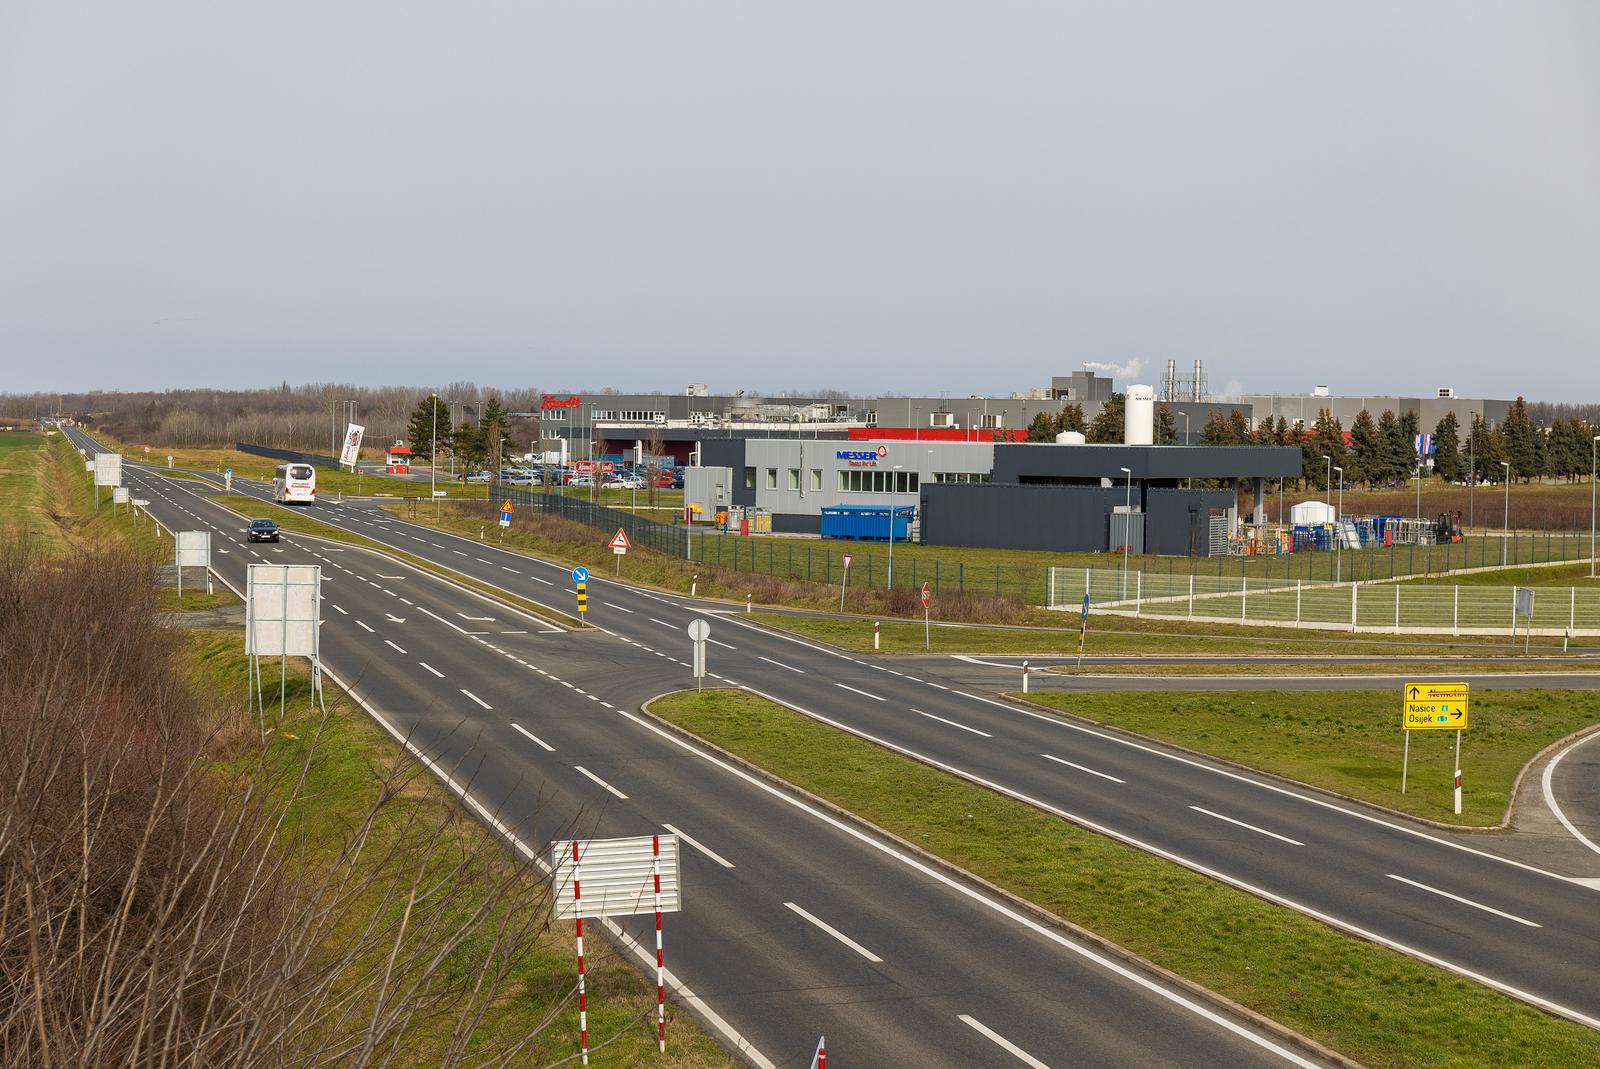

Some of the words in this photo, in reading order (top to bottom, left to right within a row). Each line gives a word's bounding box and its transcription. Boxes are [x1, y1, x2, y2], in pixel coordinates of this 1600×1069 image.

[836, 451, 878, 460] MESSER
[1409, 704, 1435, 713] Našice
[1409, 714, 1432, 724] Osijek
